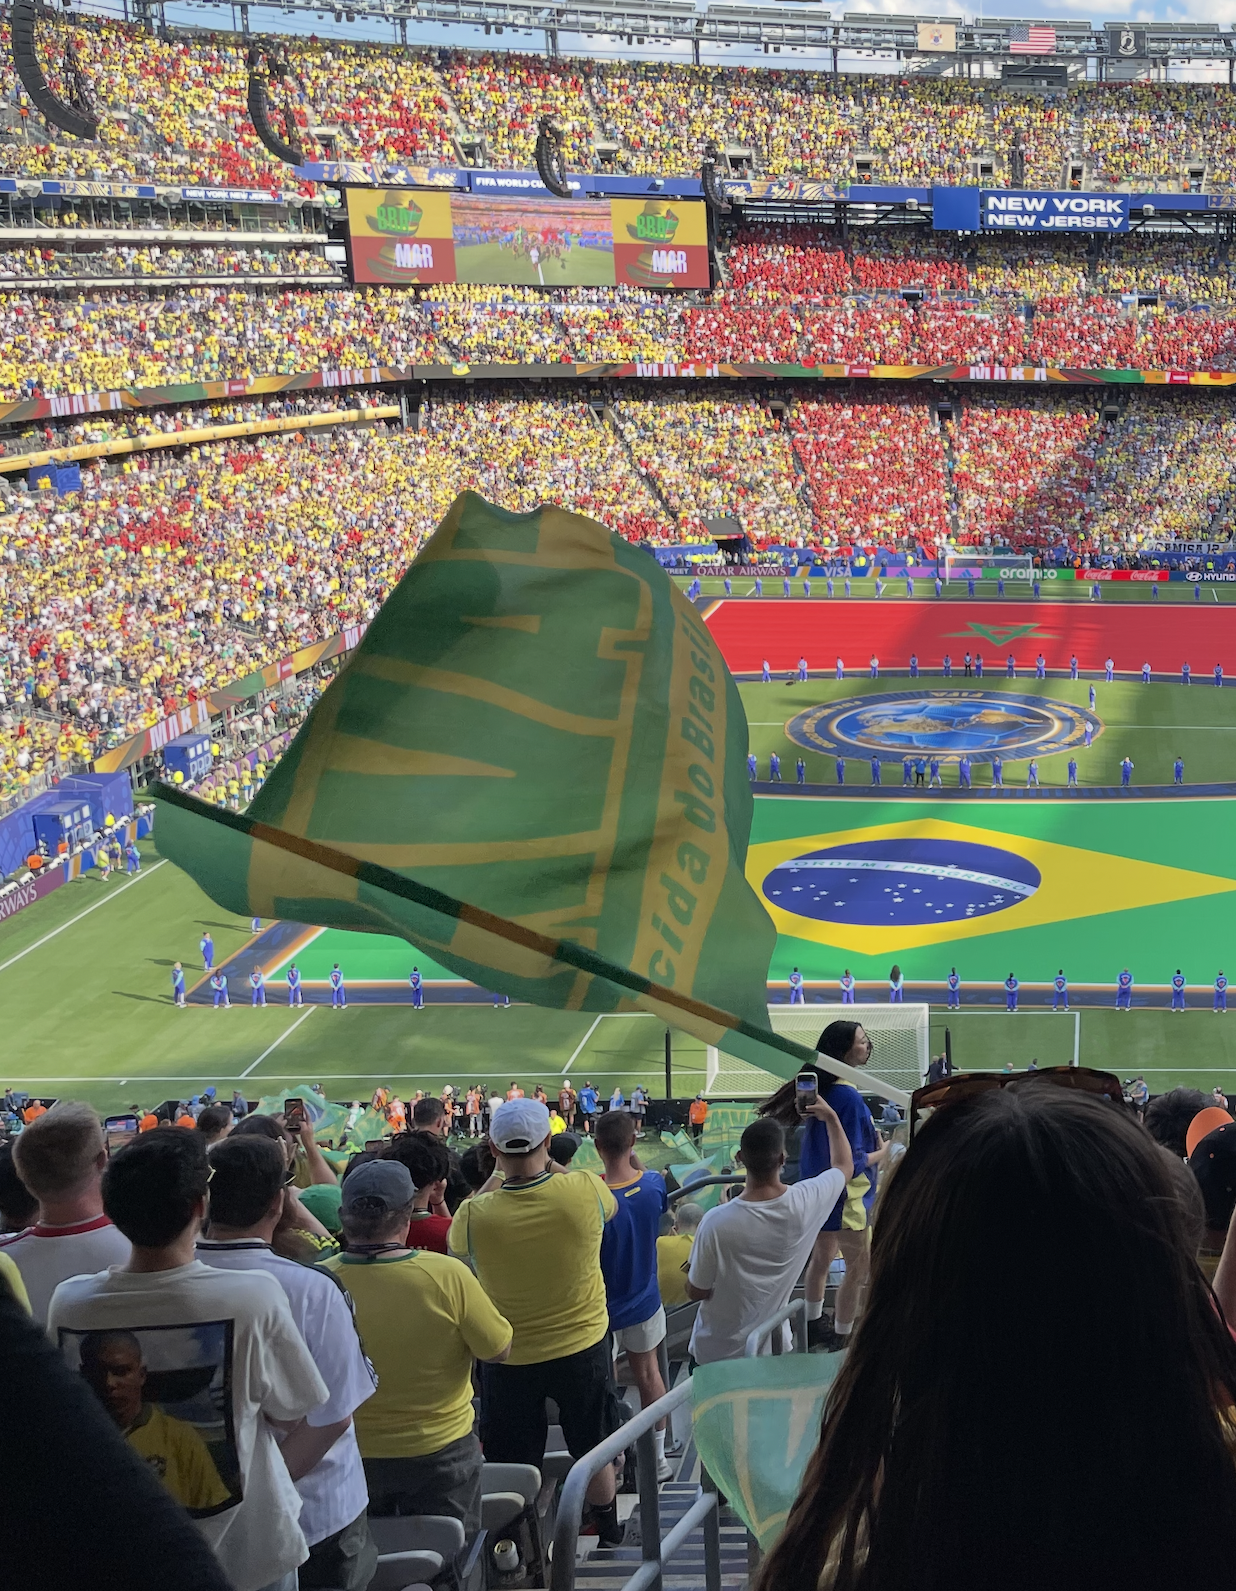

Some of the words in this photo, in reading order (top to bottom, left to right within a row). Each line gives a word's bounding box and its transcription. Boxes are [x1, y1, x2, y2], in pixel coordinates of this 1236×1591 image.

[476, 177, 497, 187] FIFA
[497, 178, 529, 188] WORLD
[186, 190, 205, 198] NEW
[206, 191, 228, 200] YORK
[229, 192, 247, 200] NEW
[988, 196, 1045, 212] NEW
[1053, 198, 1124, 214] YORK
[988, 213, 1037, 227] NEW
[1041, 215, 1124, 229] JERSEY
[395, 243, 434, 269] MAR
[652, 249, 688, 274] MAR
[696, 566, 735, 576] QATAR
[739, 566, 787, 577] AIRWAYS
[823, 567, 852, 577] VISA
[1000, 568, 1058, 579] aramco
[1083, 569, 1113, 581] Coca-Cola
[1129, 569, 1160, 581] Coca-Cola
[682, 611, 717, 761] Brasil
[683, 761, 718, 834] do
[902, 864, 1028, 892] PROGRESSO
[648, 842, 711, 988] cida
